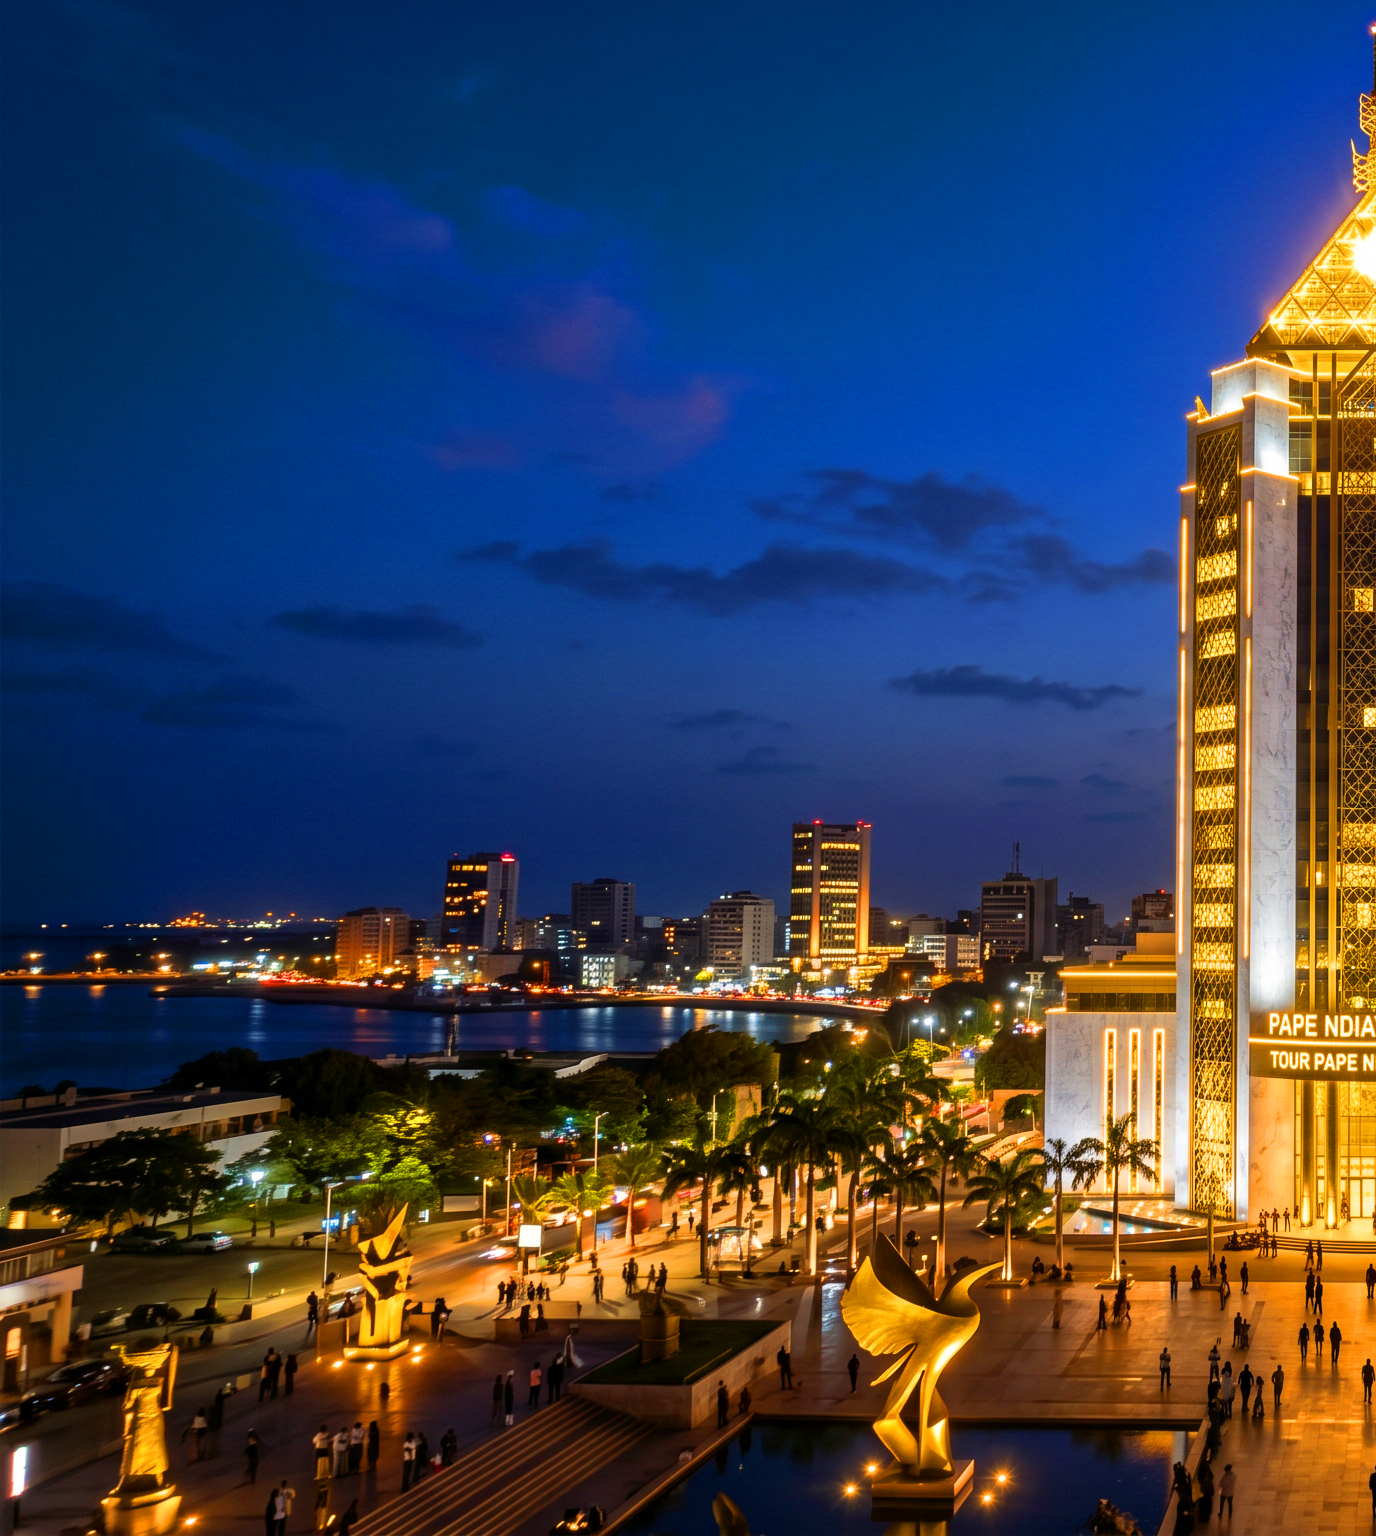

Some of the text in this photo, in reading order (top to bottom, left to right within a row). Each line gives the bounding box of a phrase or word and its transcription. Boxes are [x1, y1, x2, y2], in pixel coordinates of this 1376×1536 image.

[1269, 1013, 1318, 1036] PAPE
[1270, 1050, 1310, 1070] TOUR
[1314, 1052, 1358, 1072] PAPE
